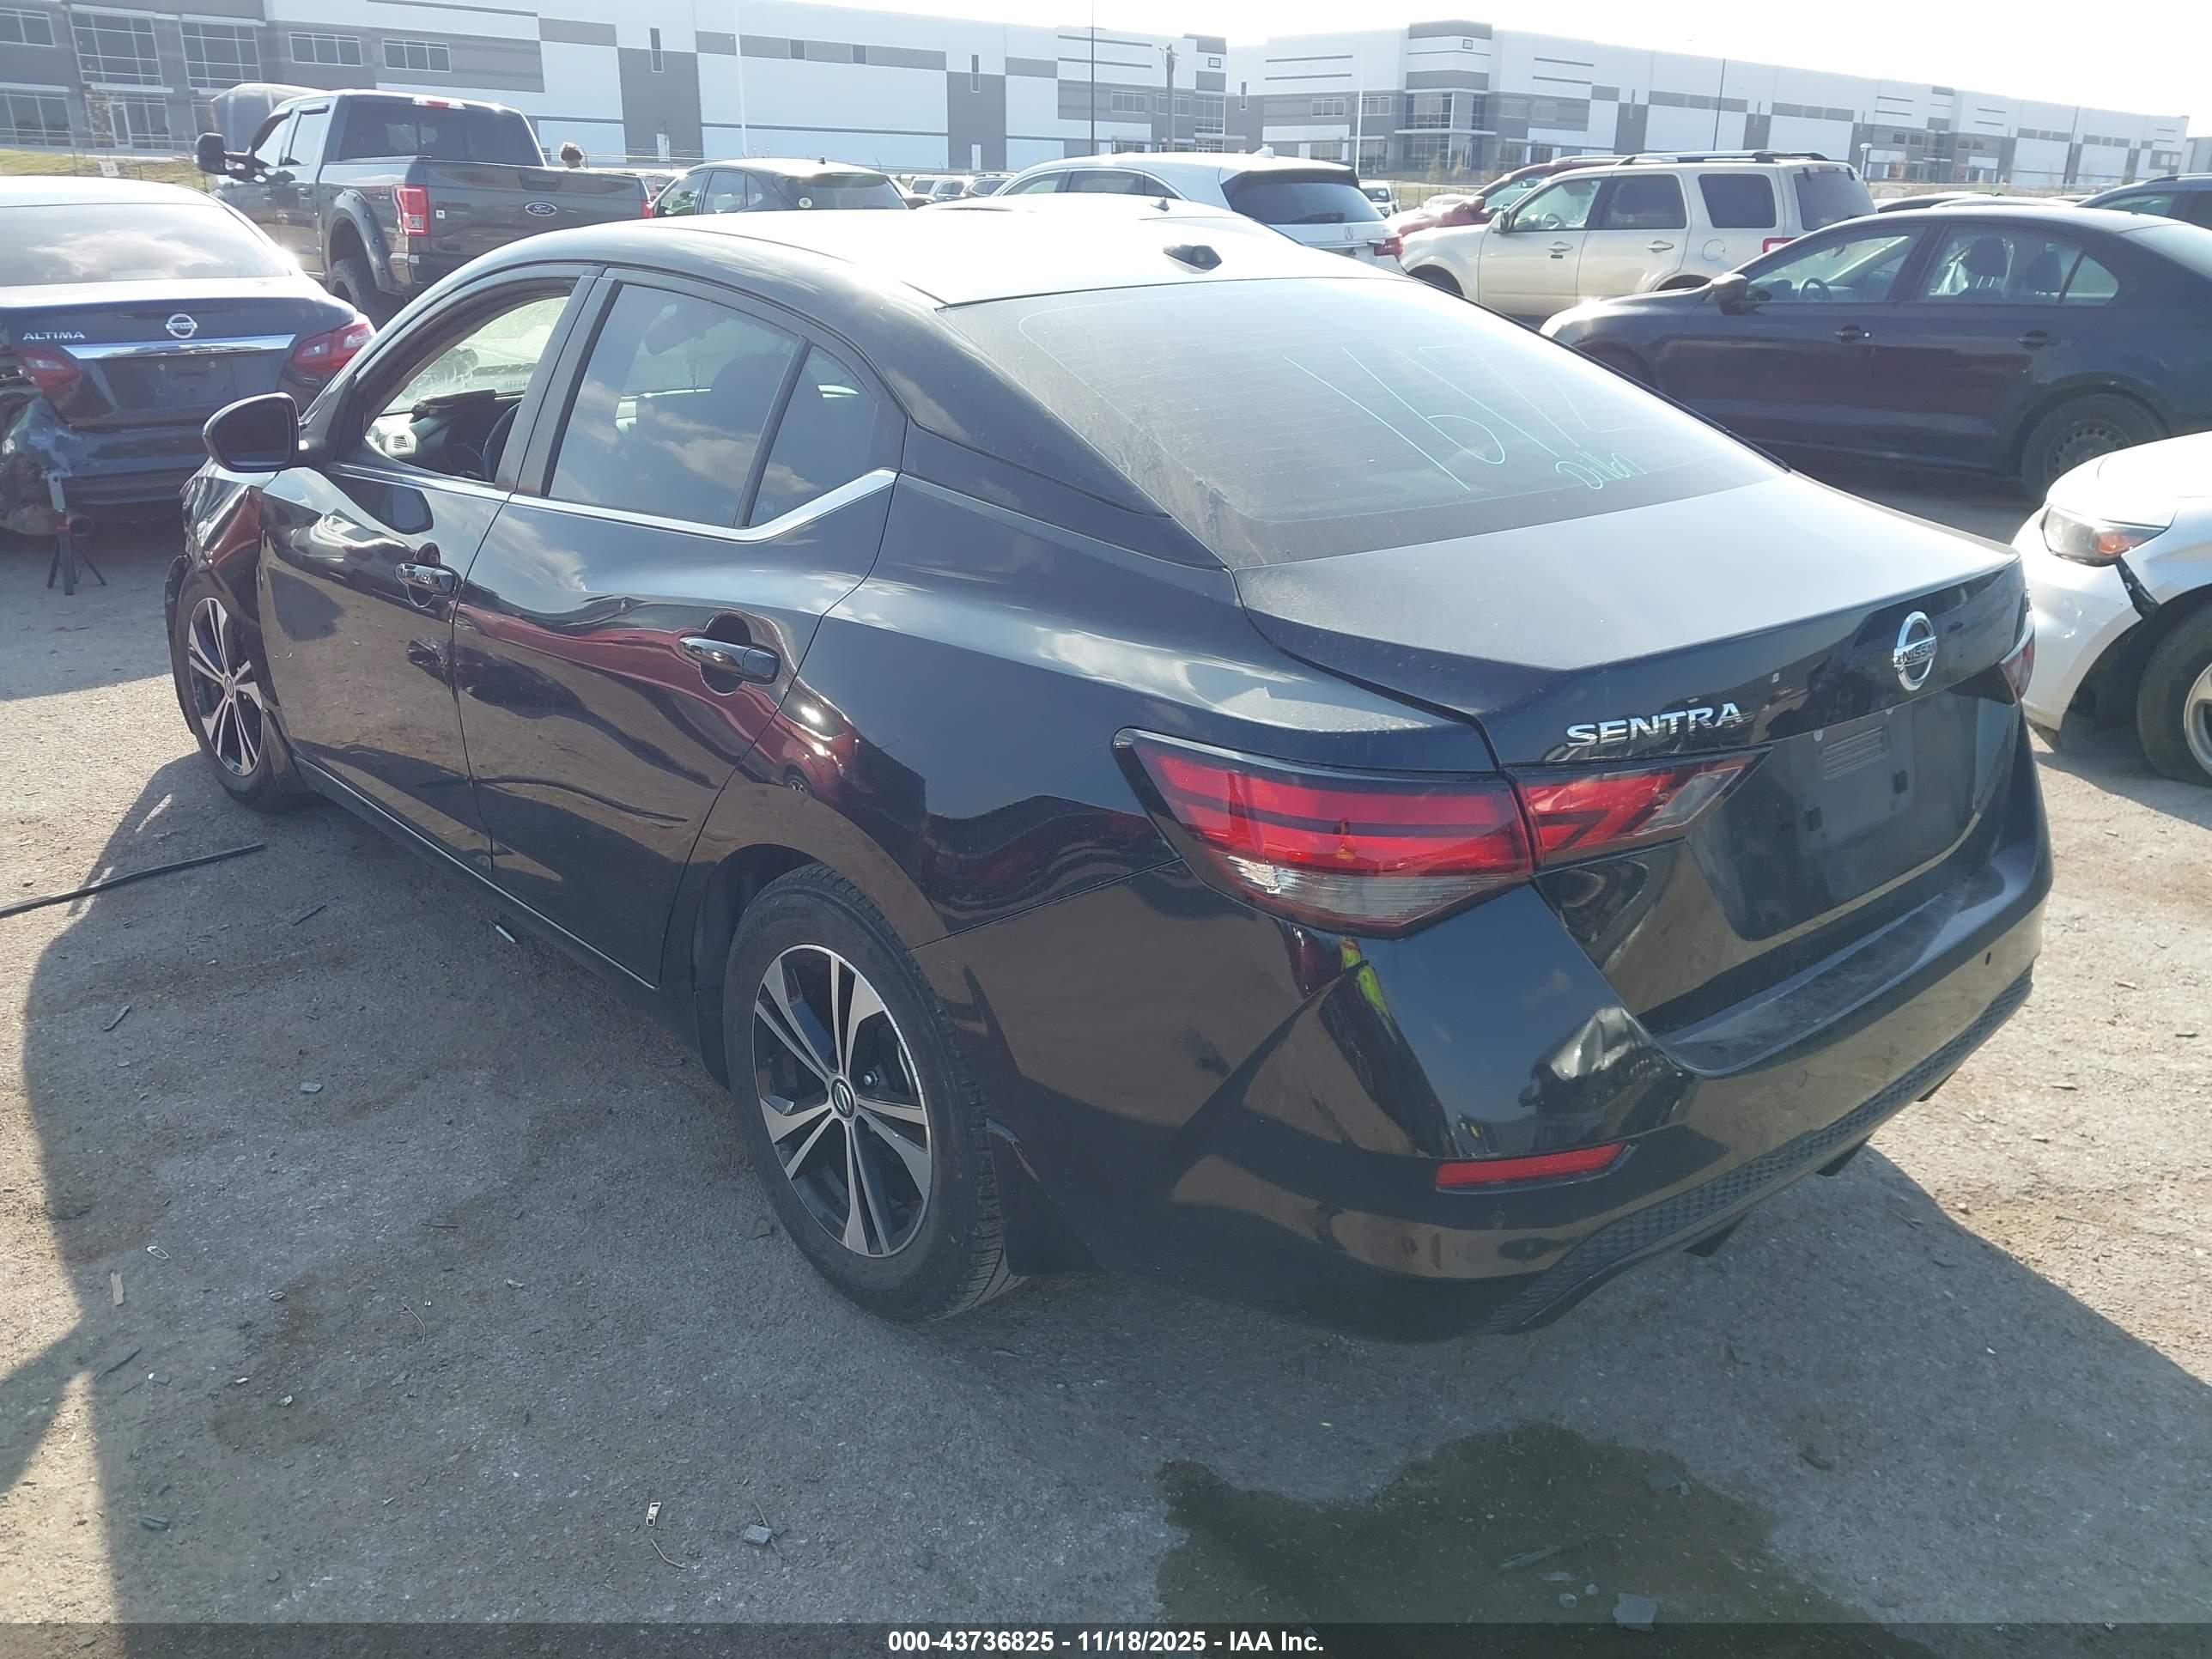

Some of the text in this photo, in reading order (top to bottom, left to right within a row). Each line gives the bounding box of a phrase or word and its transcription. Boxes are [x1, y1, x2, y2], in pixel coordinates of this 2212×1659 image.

[22, 331, 85, 340] ALTIMA
[1903, 641, 1936, 661] NISSAN
[1566, 702, 1743, 747] SENTRA
